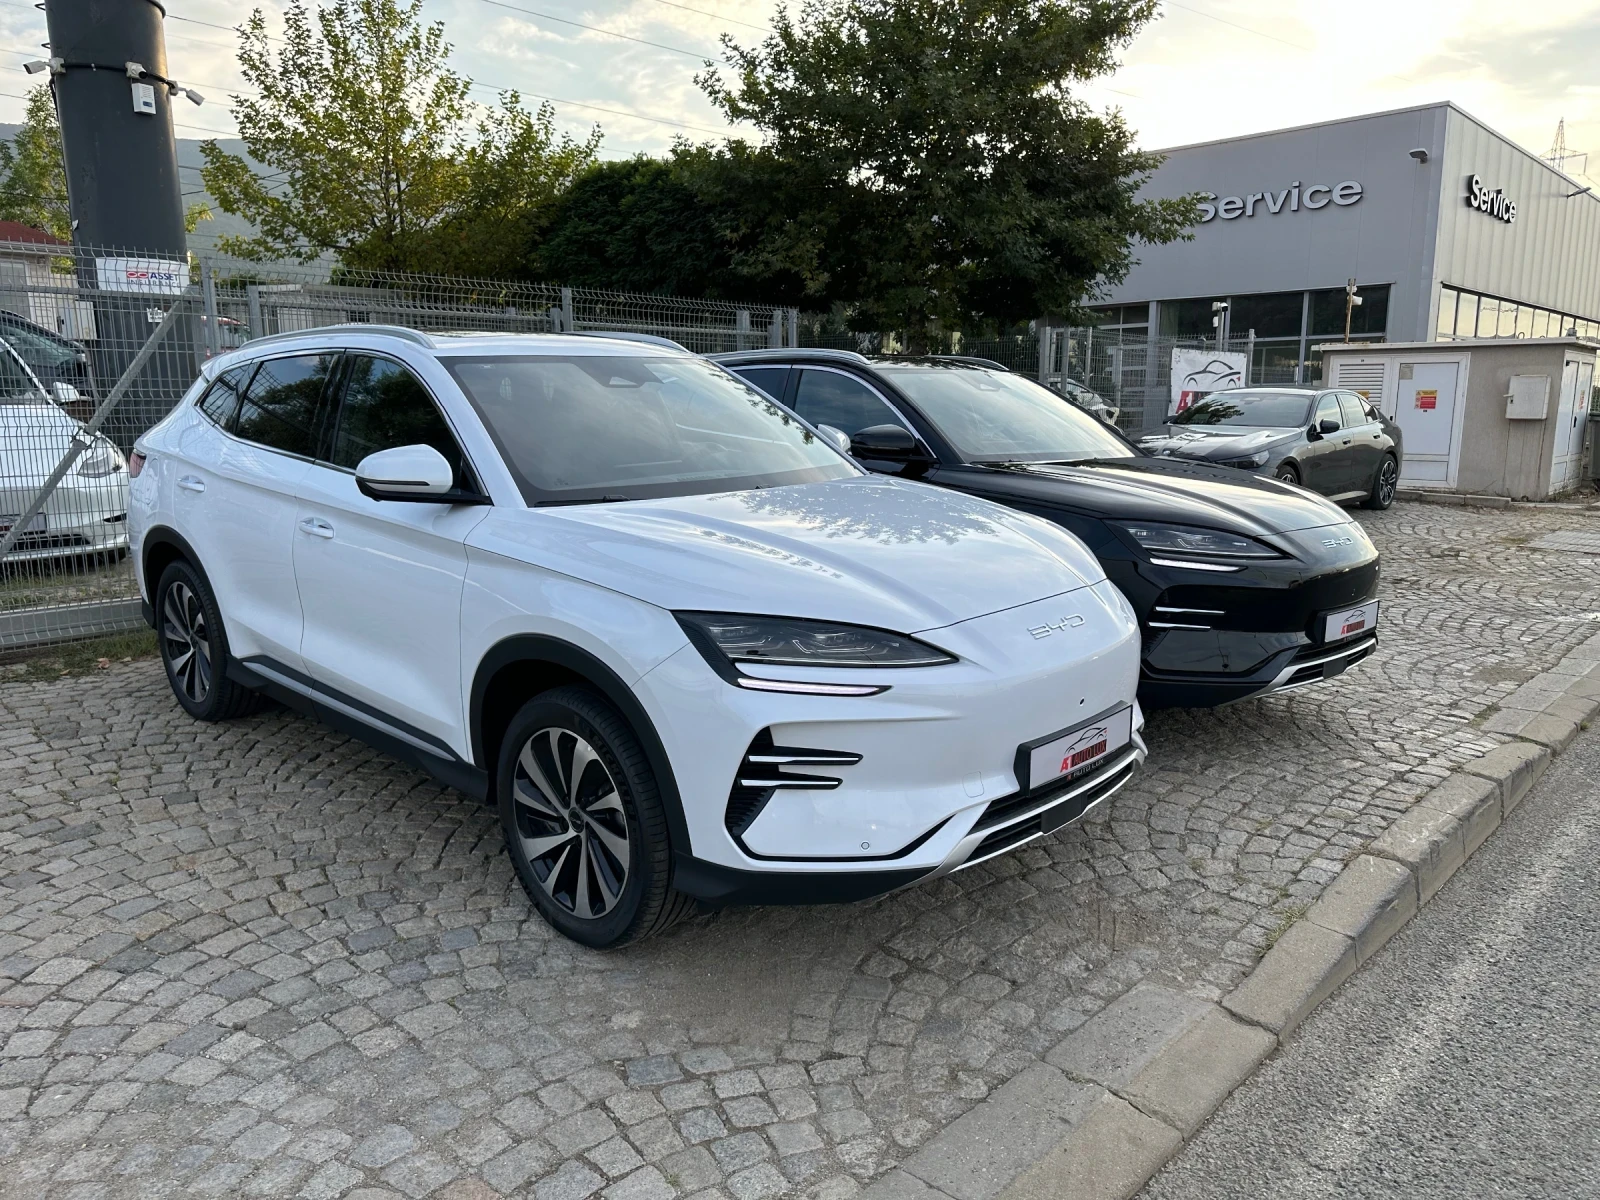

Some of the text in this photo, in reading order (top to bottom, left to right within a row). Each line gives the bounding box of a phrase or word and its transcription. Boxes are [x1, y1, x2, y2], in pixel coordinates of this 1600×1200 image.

[1195, 180, 1363, 223] Service
[1469, 174, 1517, 223] Service
[150, 272, 179, 281] ASSET
[1322, 537, 1354, 548] BYD
[1027, 613, 1086, 640] BYD
[1060, 739, 1107, 773] A1 AUTO LUX
